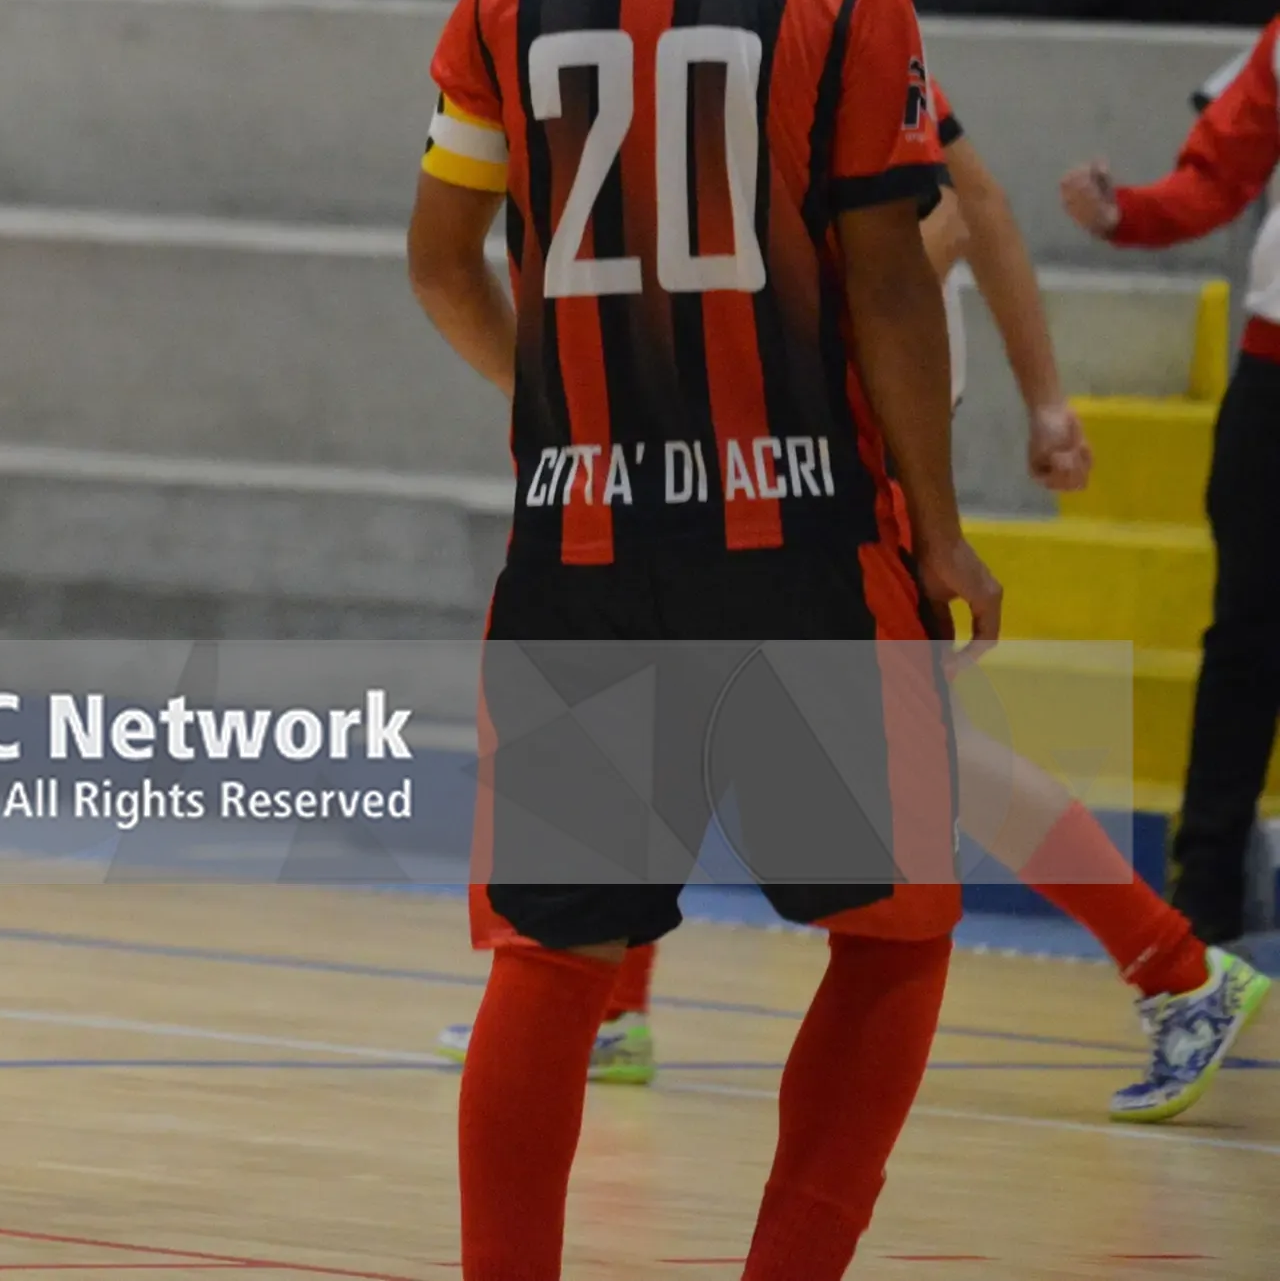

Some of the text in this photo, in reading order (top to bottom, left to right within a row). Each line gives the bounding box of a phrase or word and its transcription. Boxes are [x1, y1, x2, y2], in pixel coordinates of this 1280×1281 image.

[528, 25, 767, 299] 20
[526, 436, 836, 508] CITTA' DI ACRI
